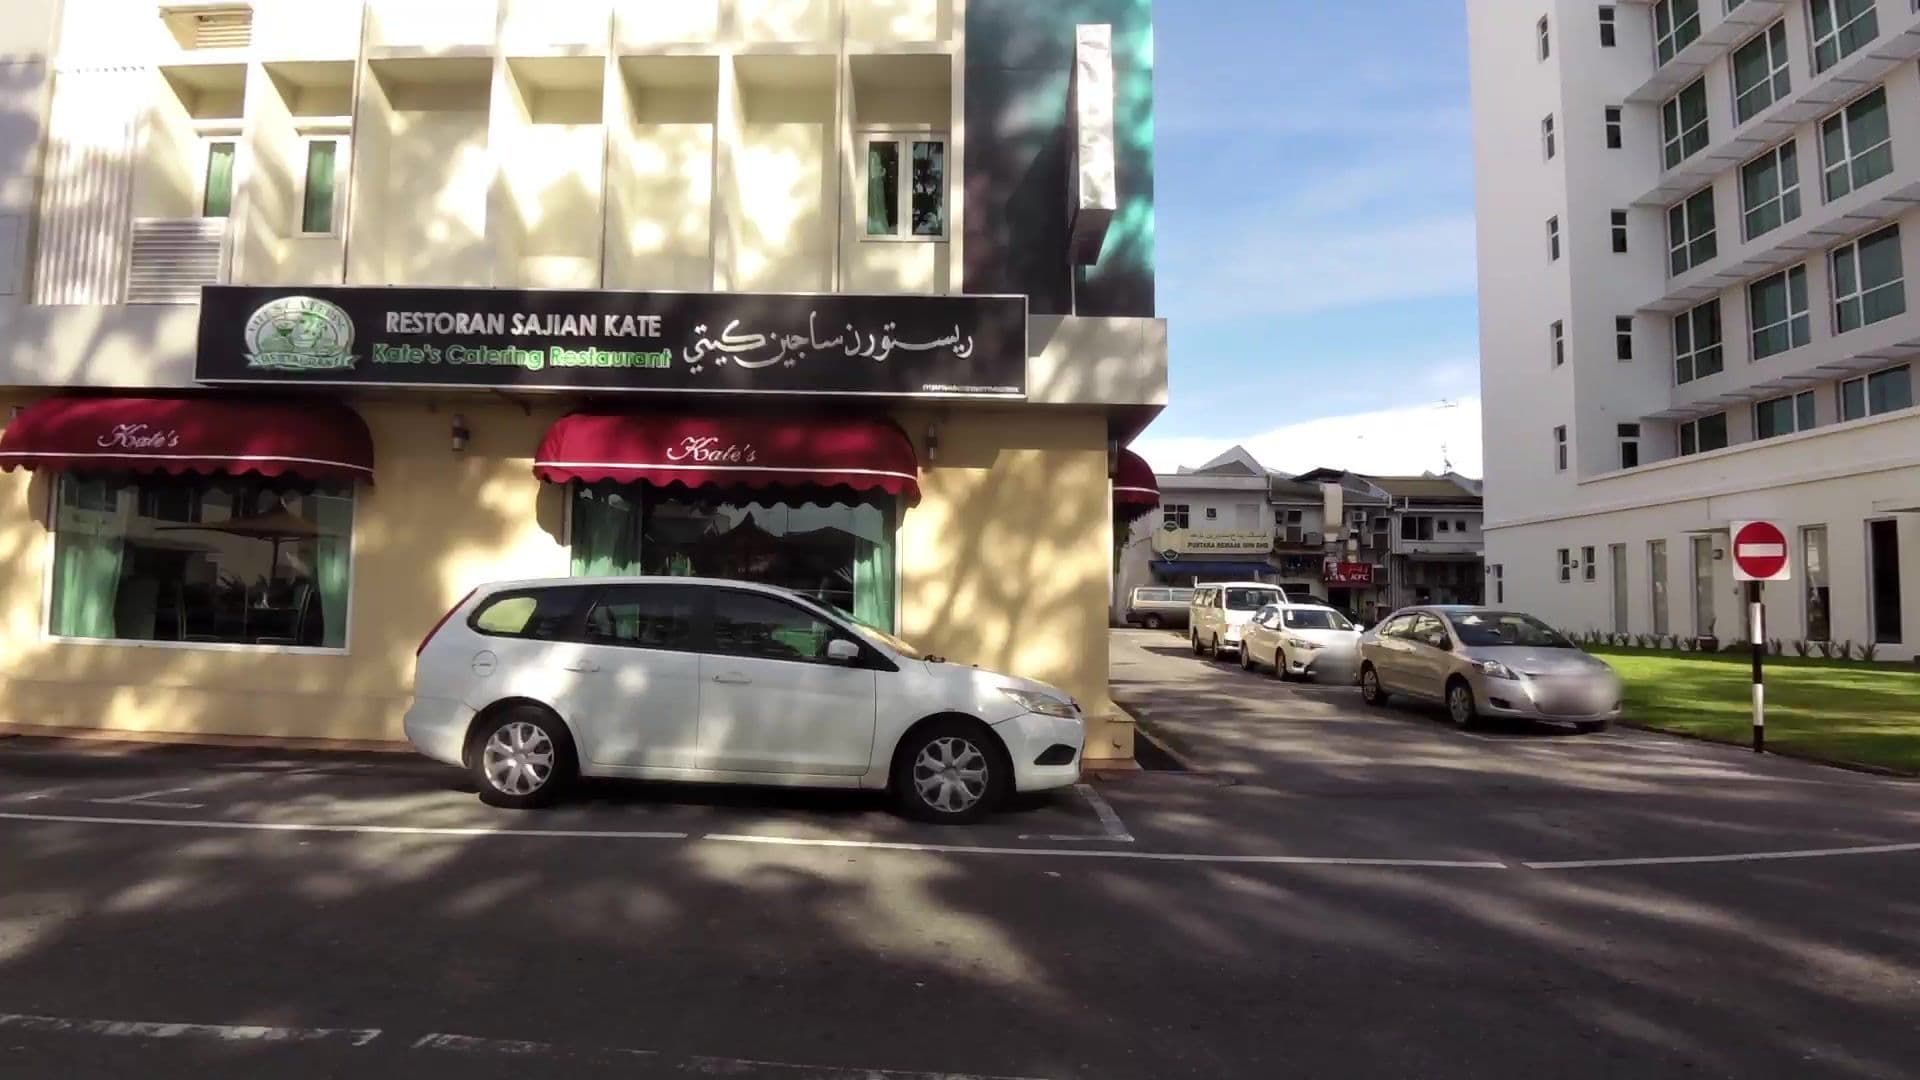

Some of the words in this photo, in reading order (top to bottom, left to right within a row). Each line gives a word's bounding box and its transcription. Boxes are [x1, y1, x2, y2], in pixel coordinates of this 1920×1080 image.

[386, 311, 505, 335] RESTORAN
[510, 313, 597, 336] SAJIAN
[604, 315, 661, 337] KATE
[372, 343, 442, 364] Kate's
[445, 344, 544, 370] Catering
[550, 346, 672, 369] Restaurant
[97, 424, 178, 448] Kate's
[666, 436, 756, 462] Kate's
